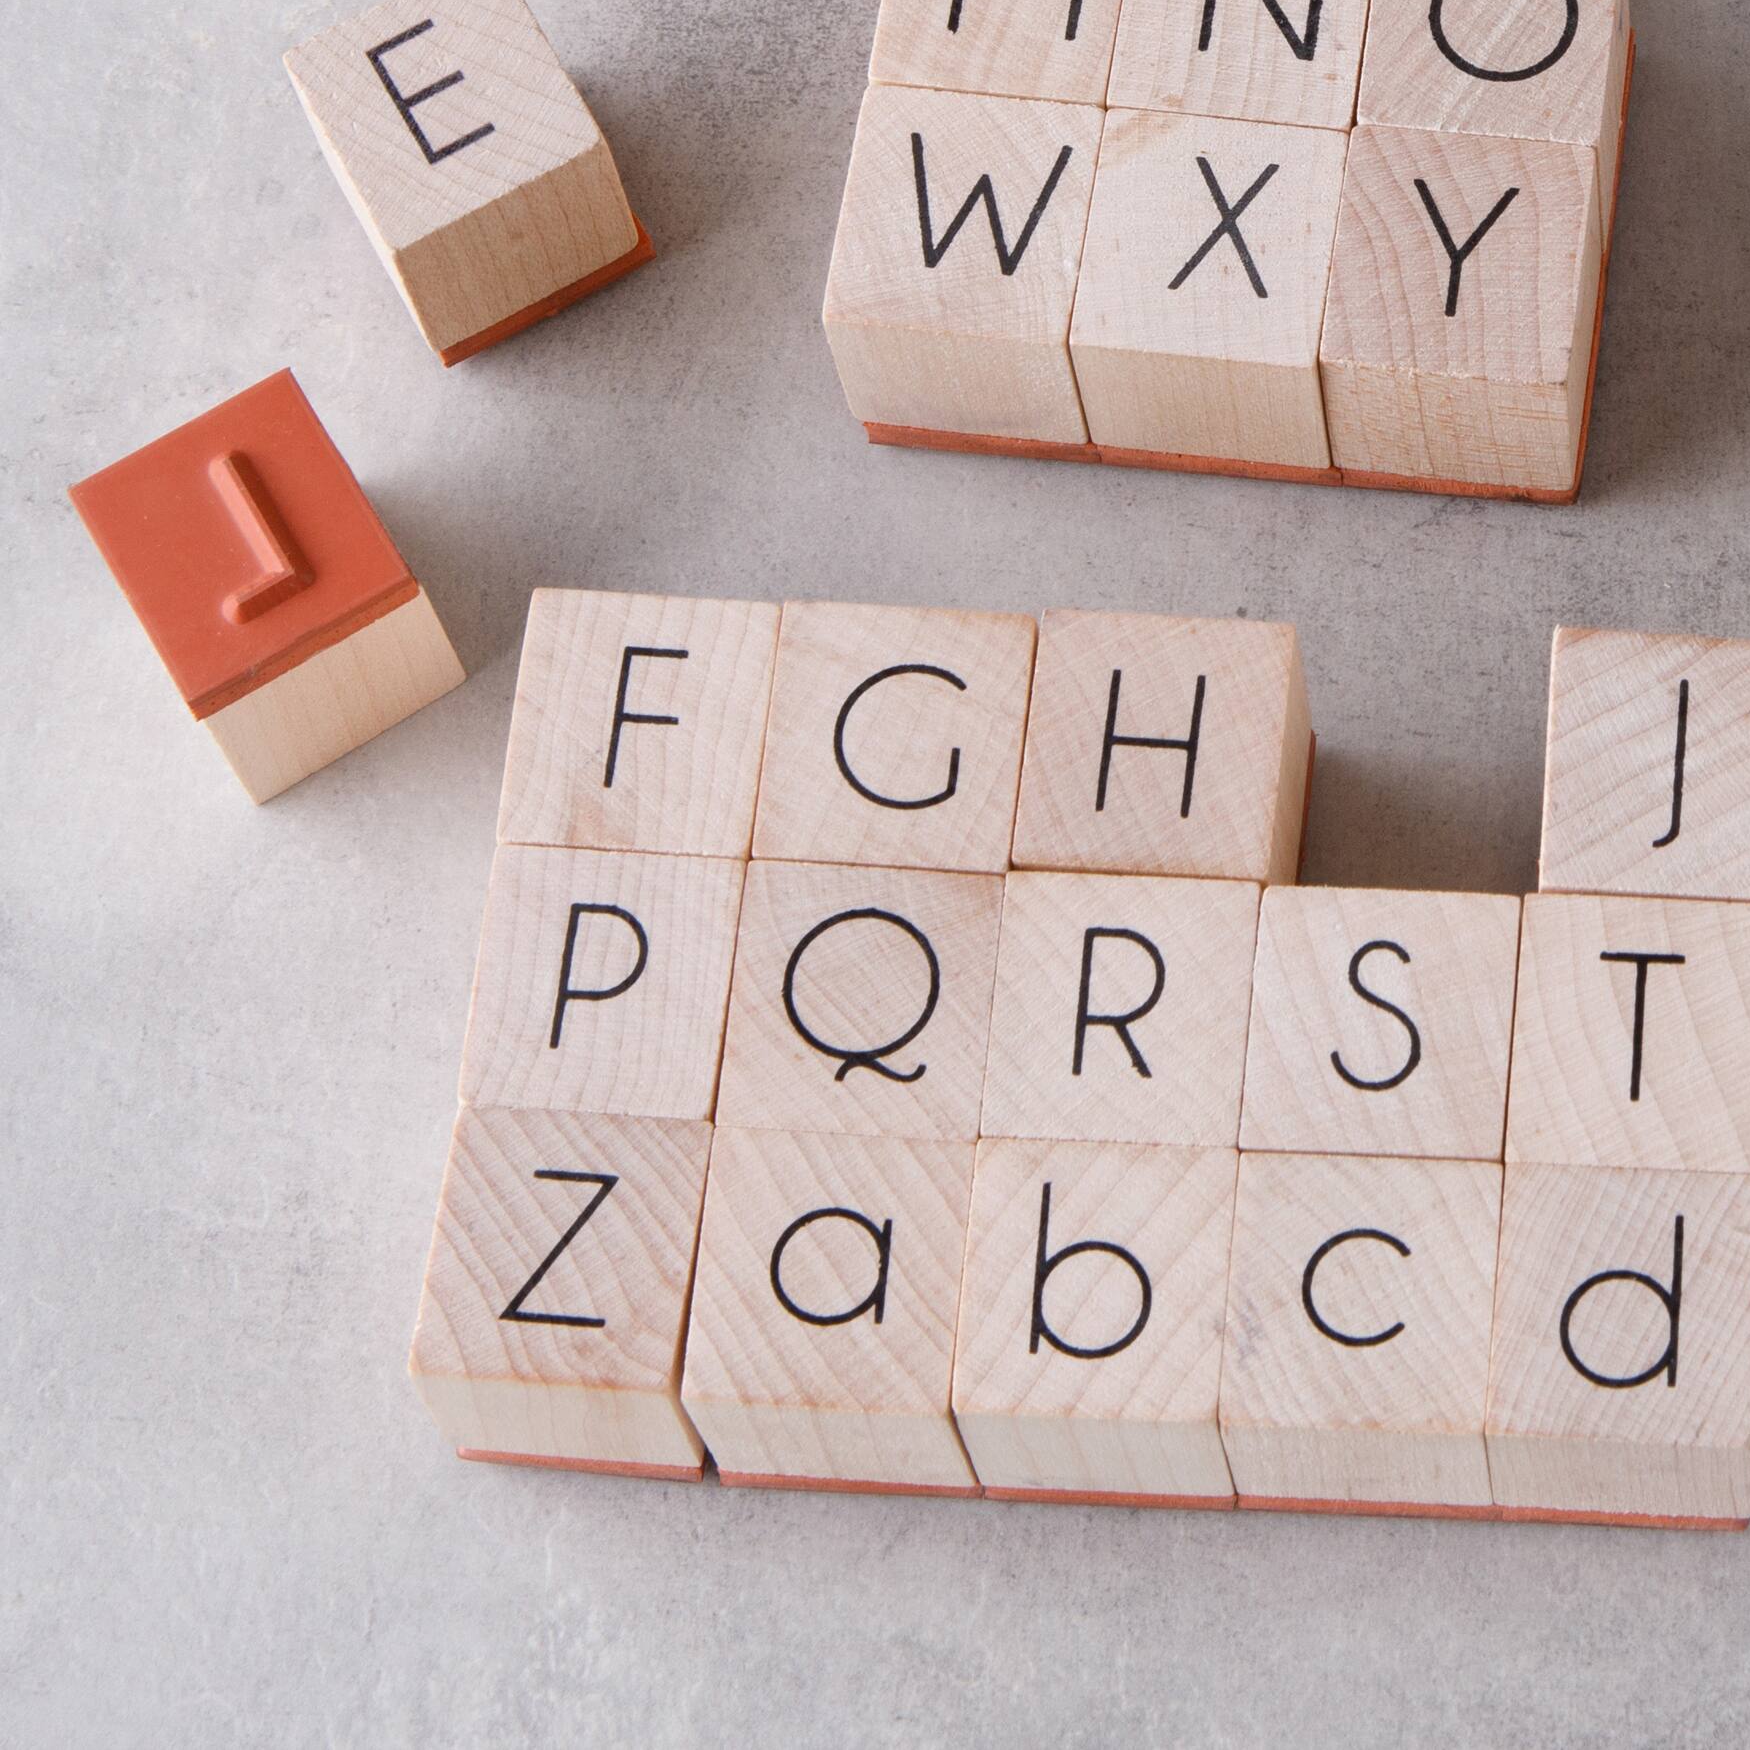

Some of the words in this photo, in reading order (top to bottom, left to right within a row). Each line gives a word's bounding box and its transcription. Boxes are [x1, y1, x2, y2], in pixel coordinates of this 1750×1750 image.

[367, 19, 495, 165] E
[911, 132, 1073, 276] W
[1168, 156, 1280, 299] X
[1413, 178, 1520, 317] Y
[604, 646, 689, 788] F
[833, 664, 967, 810] G
[1095, 669, 1206, 818] H
[1652, 679, 1689, 848] J
[550, 903, 648, 1049] P
[782, 907, 940, 1083] Q
[1072, 927, 1166, 1078] R
[1330, 940, 1421, 1091] S
[1600, 952, 1686, 1101] T
[499, 1170, 619, 1328] Z
[770, 1207, 892, 1326] a
[1030, 1182, 1152, 1359] b
[1301, 1229, 1411, 1347] c
[1559, 1215, 1684, 1388] d
